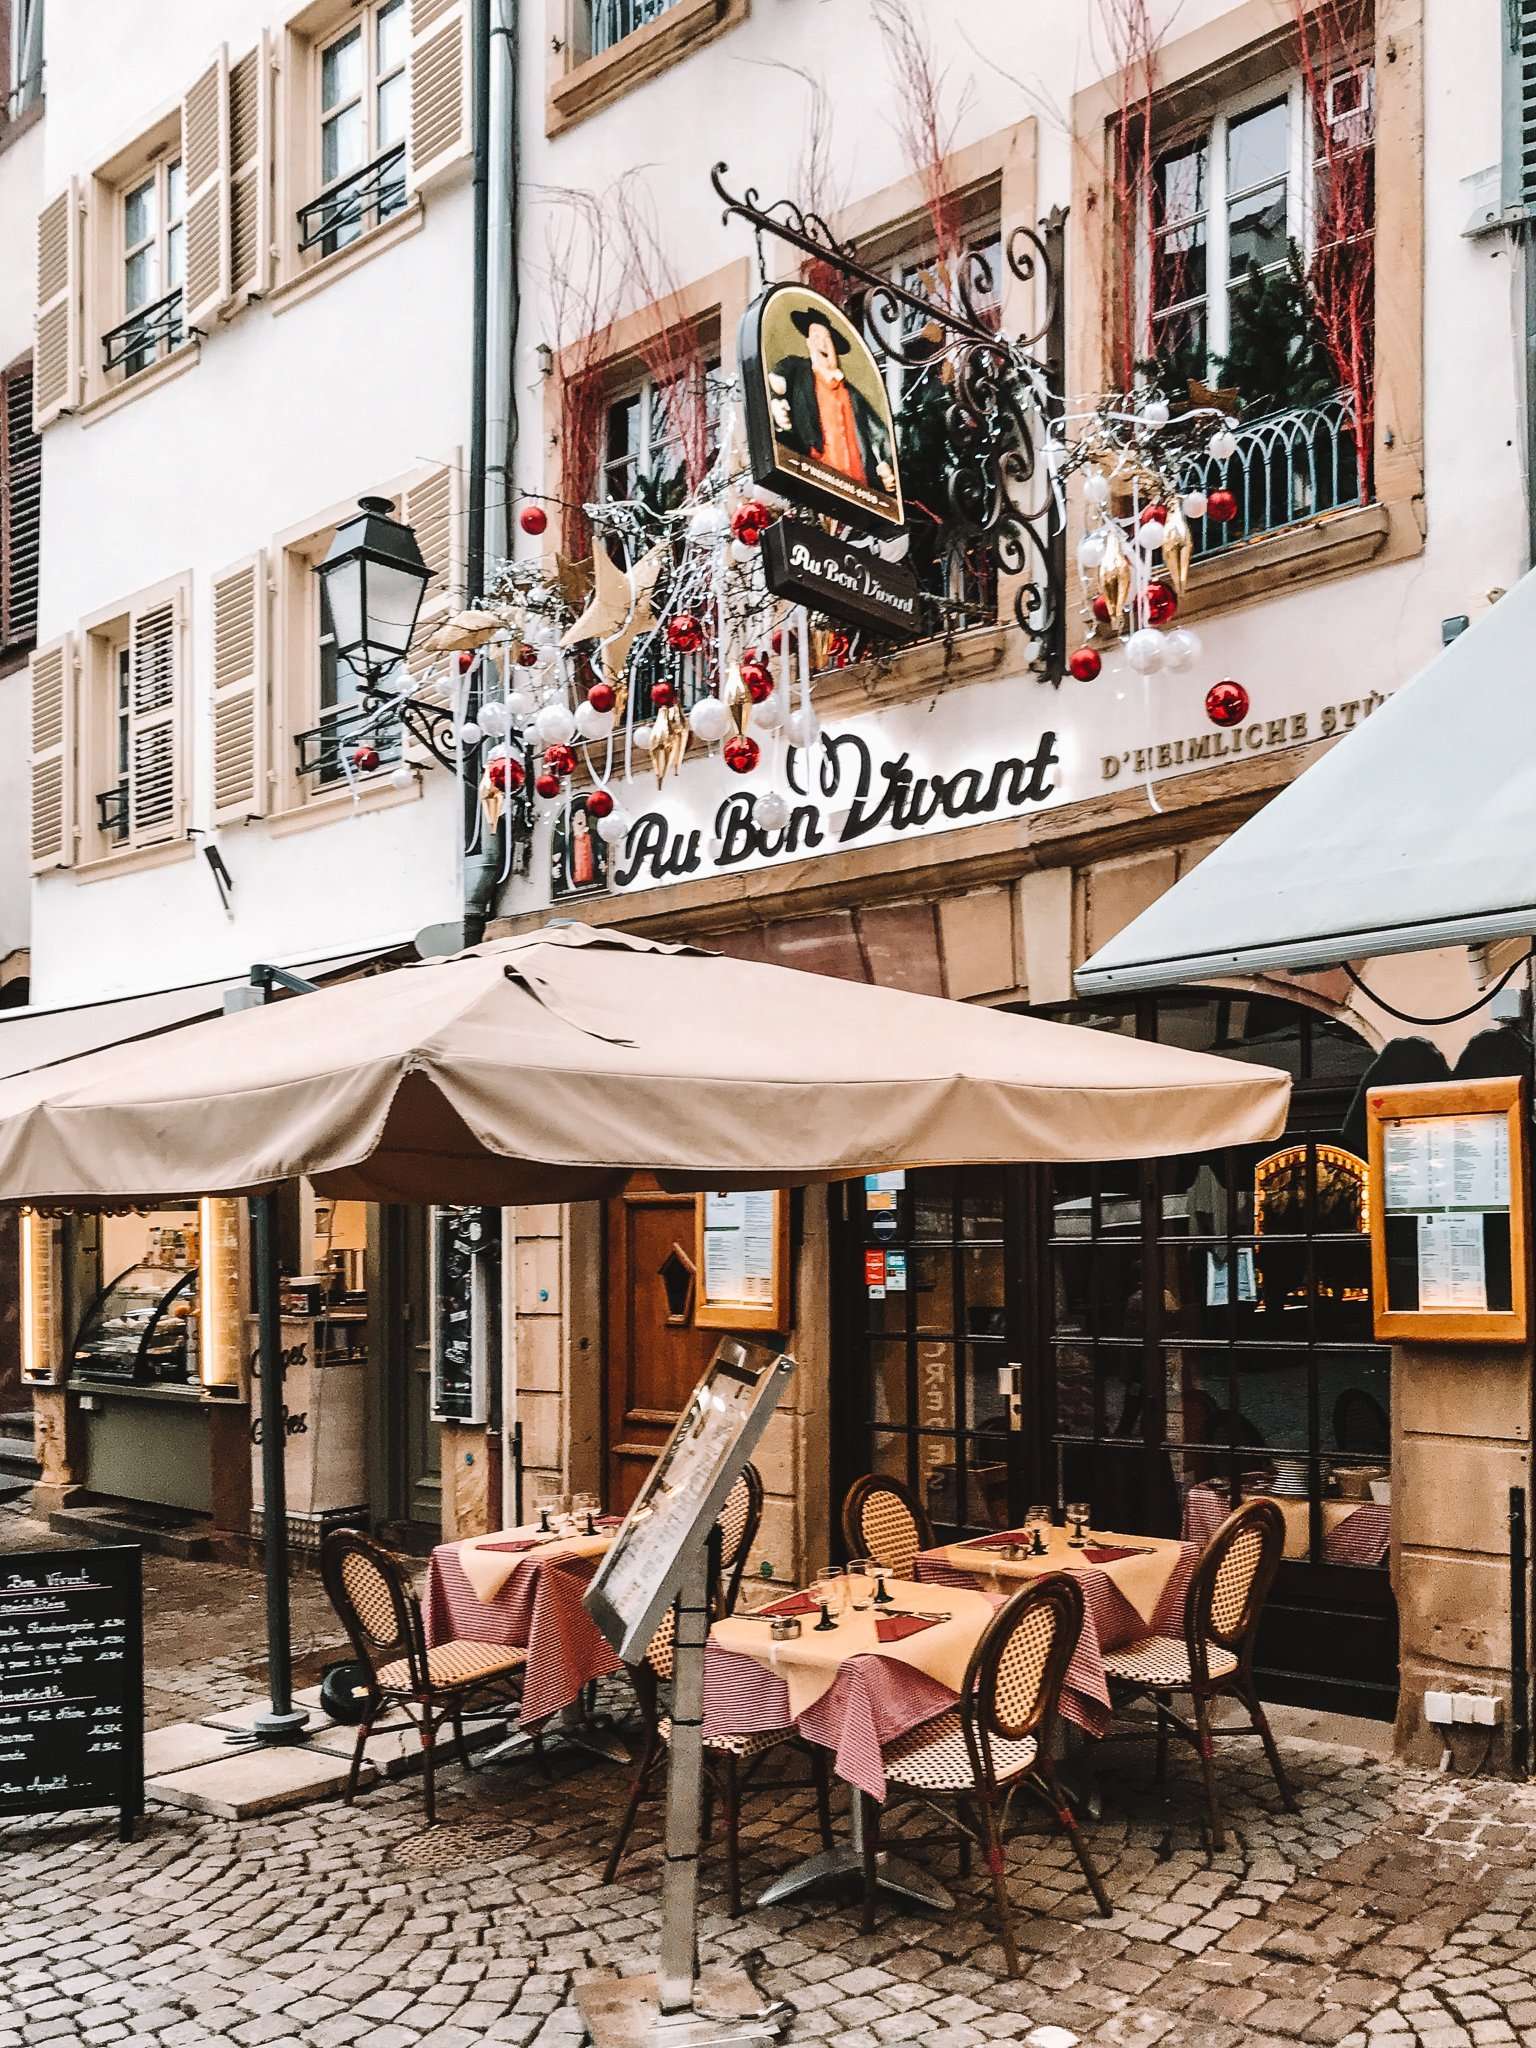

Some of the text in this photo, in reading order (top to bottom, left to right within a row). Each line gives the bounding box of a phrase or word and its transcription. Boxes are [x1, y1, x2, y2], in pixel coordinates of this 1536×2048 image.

[789, 543, 823, 576] Au
[822, 558, 859, 591] Bon
[1100, 712, 1309, 780] D'HEIMLICHE
[614, 811, 702, 887] Au
[786, 730, 1060, 843] Vivant
